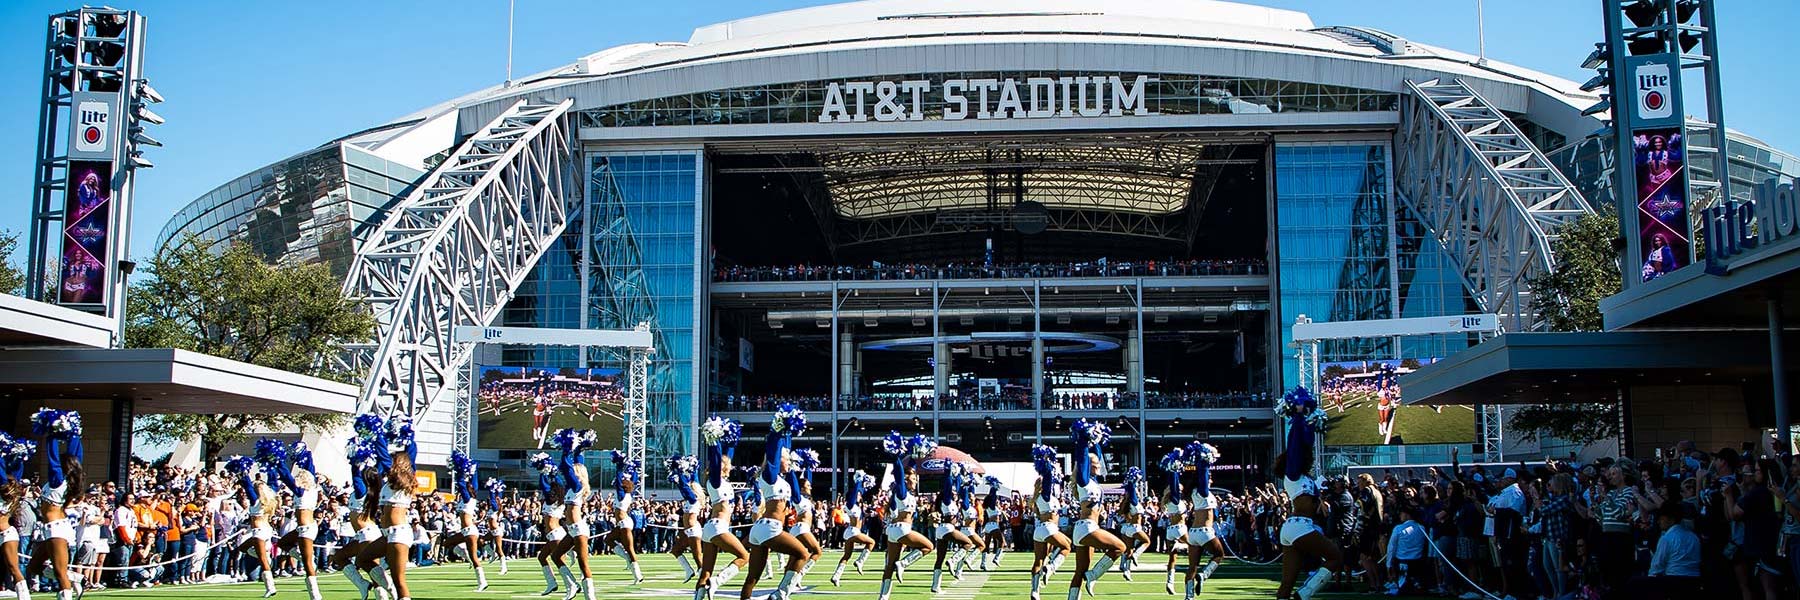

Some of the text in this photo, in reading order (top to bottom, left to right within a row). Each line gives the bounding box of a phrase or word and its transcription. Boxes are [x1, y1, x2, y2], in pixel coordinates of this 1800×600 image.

[1638, 73, 1668, 91] Lite
[818, 75, 1149, 123] AT&T STADIUM
[81, 109, 108, 126] Lite
[1462, 316, 1481, 329] Lite
[484, 328, 503, 340] Lite
